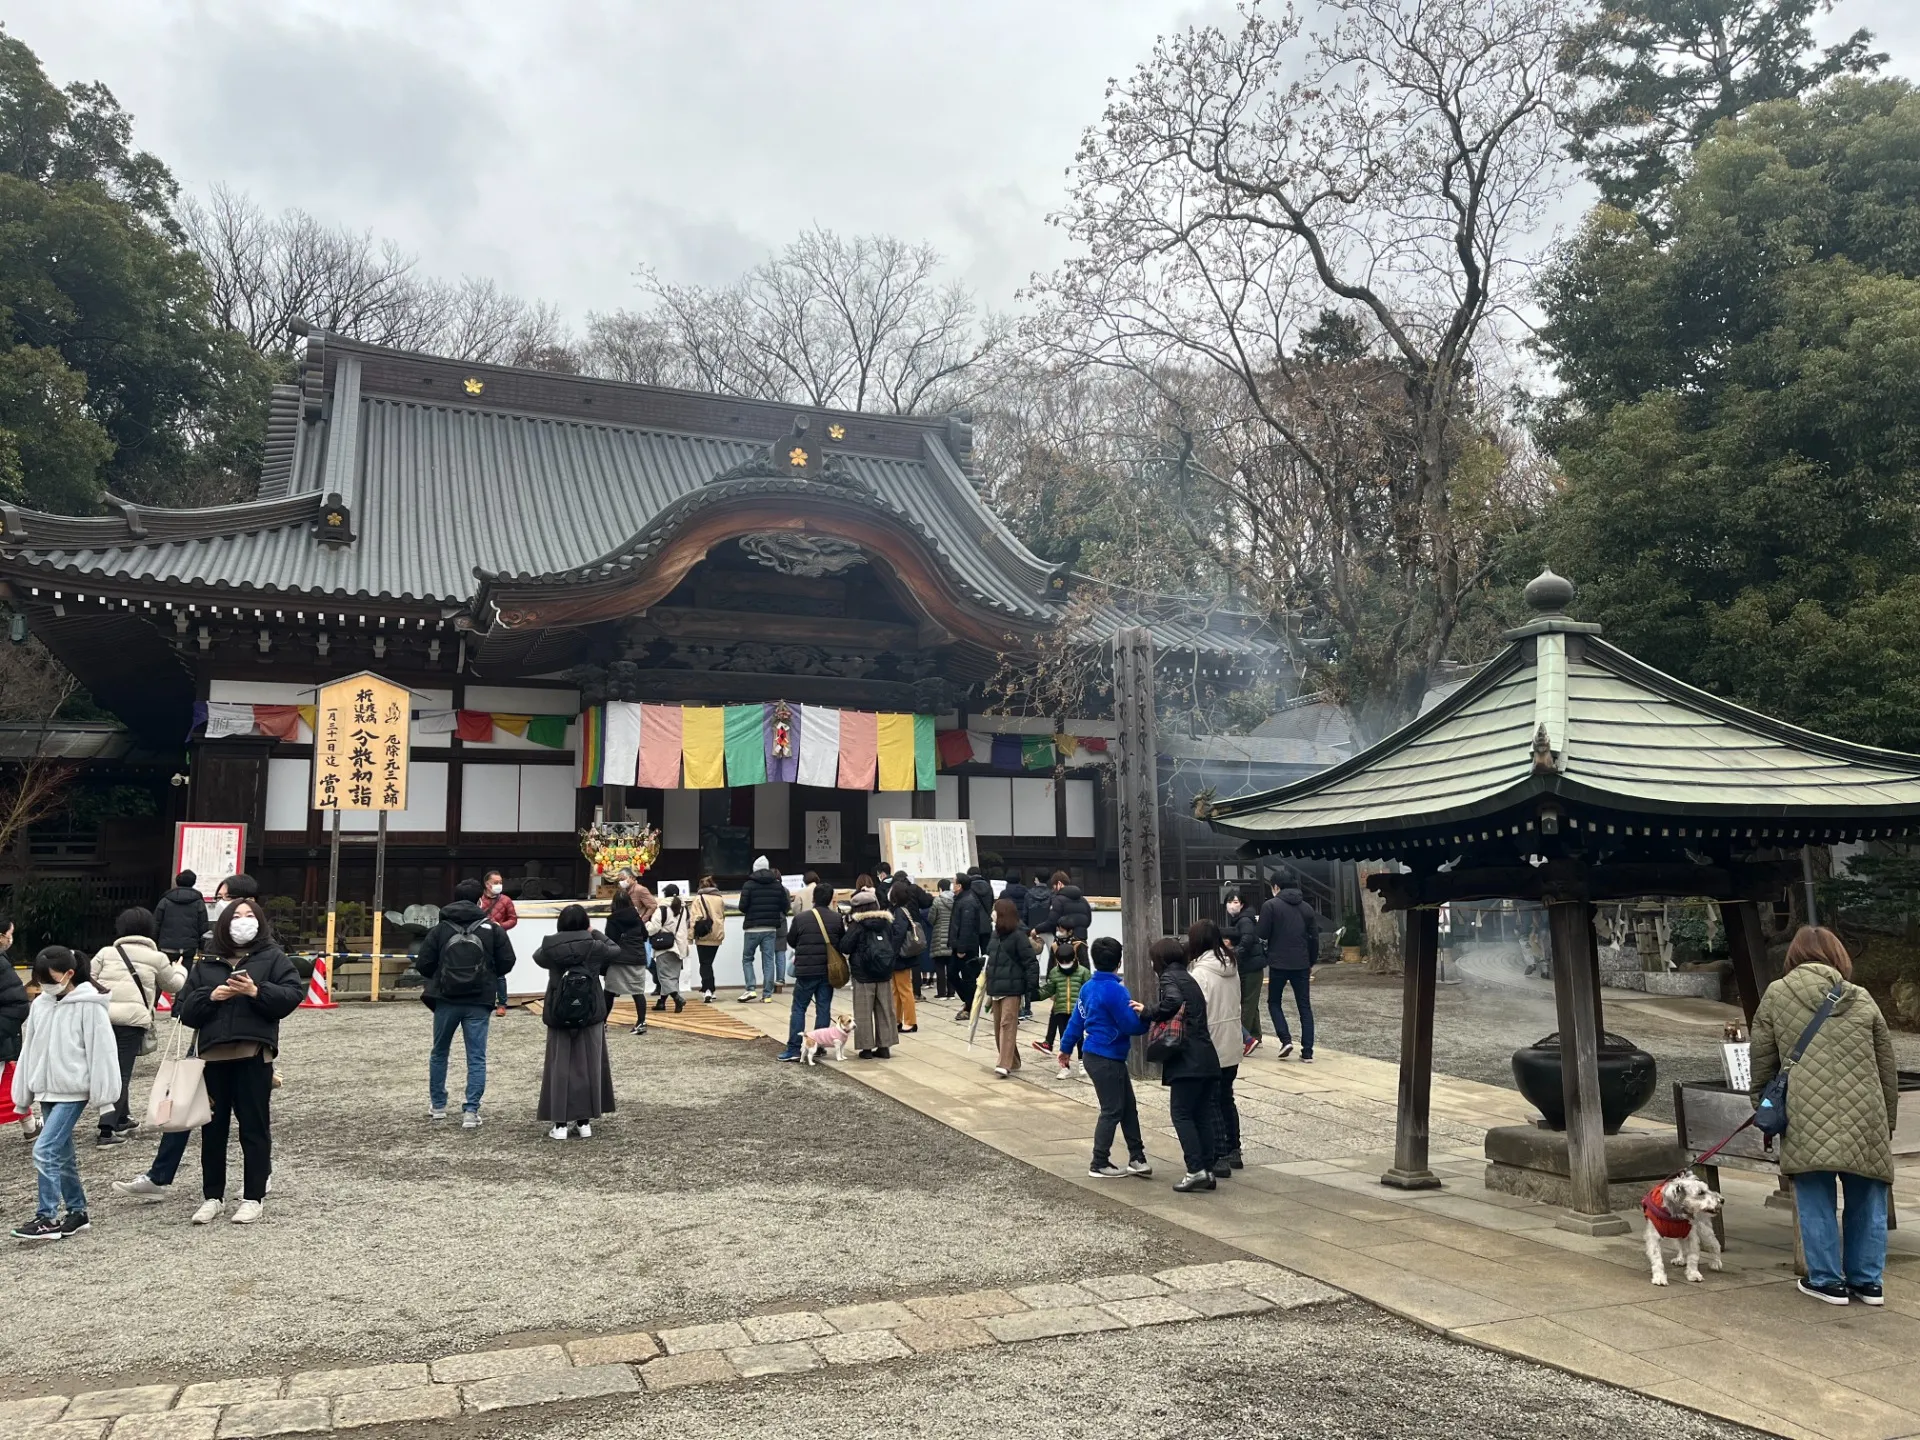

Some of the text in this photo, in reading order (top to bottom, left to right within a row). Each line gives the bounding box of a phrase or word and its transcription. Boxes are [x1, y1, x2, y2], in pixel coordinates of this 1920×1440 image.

[348, 728, 380, 808] 分散初詣
[383, 734, 401, 808] 厄除元三大師
